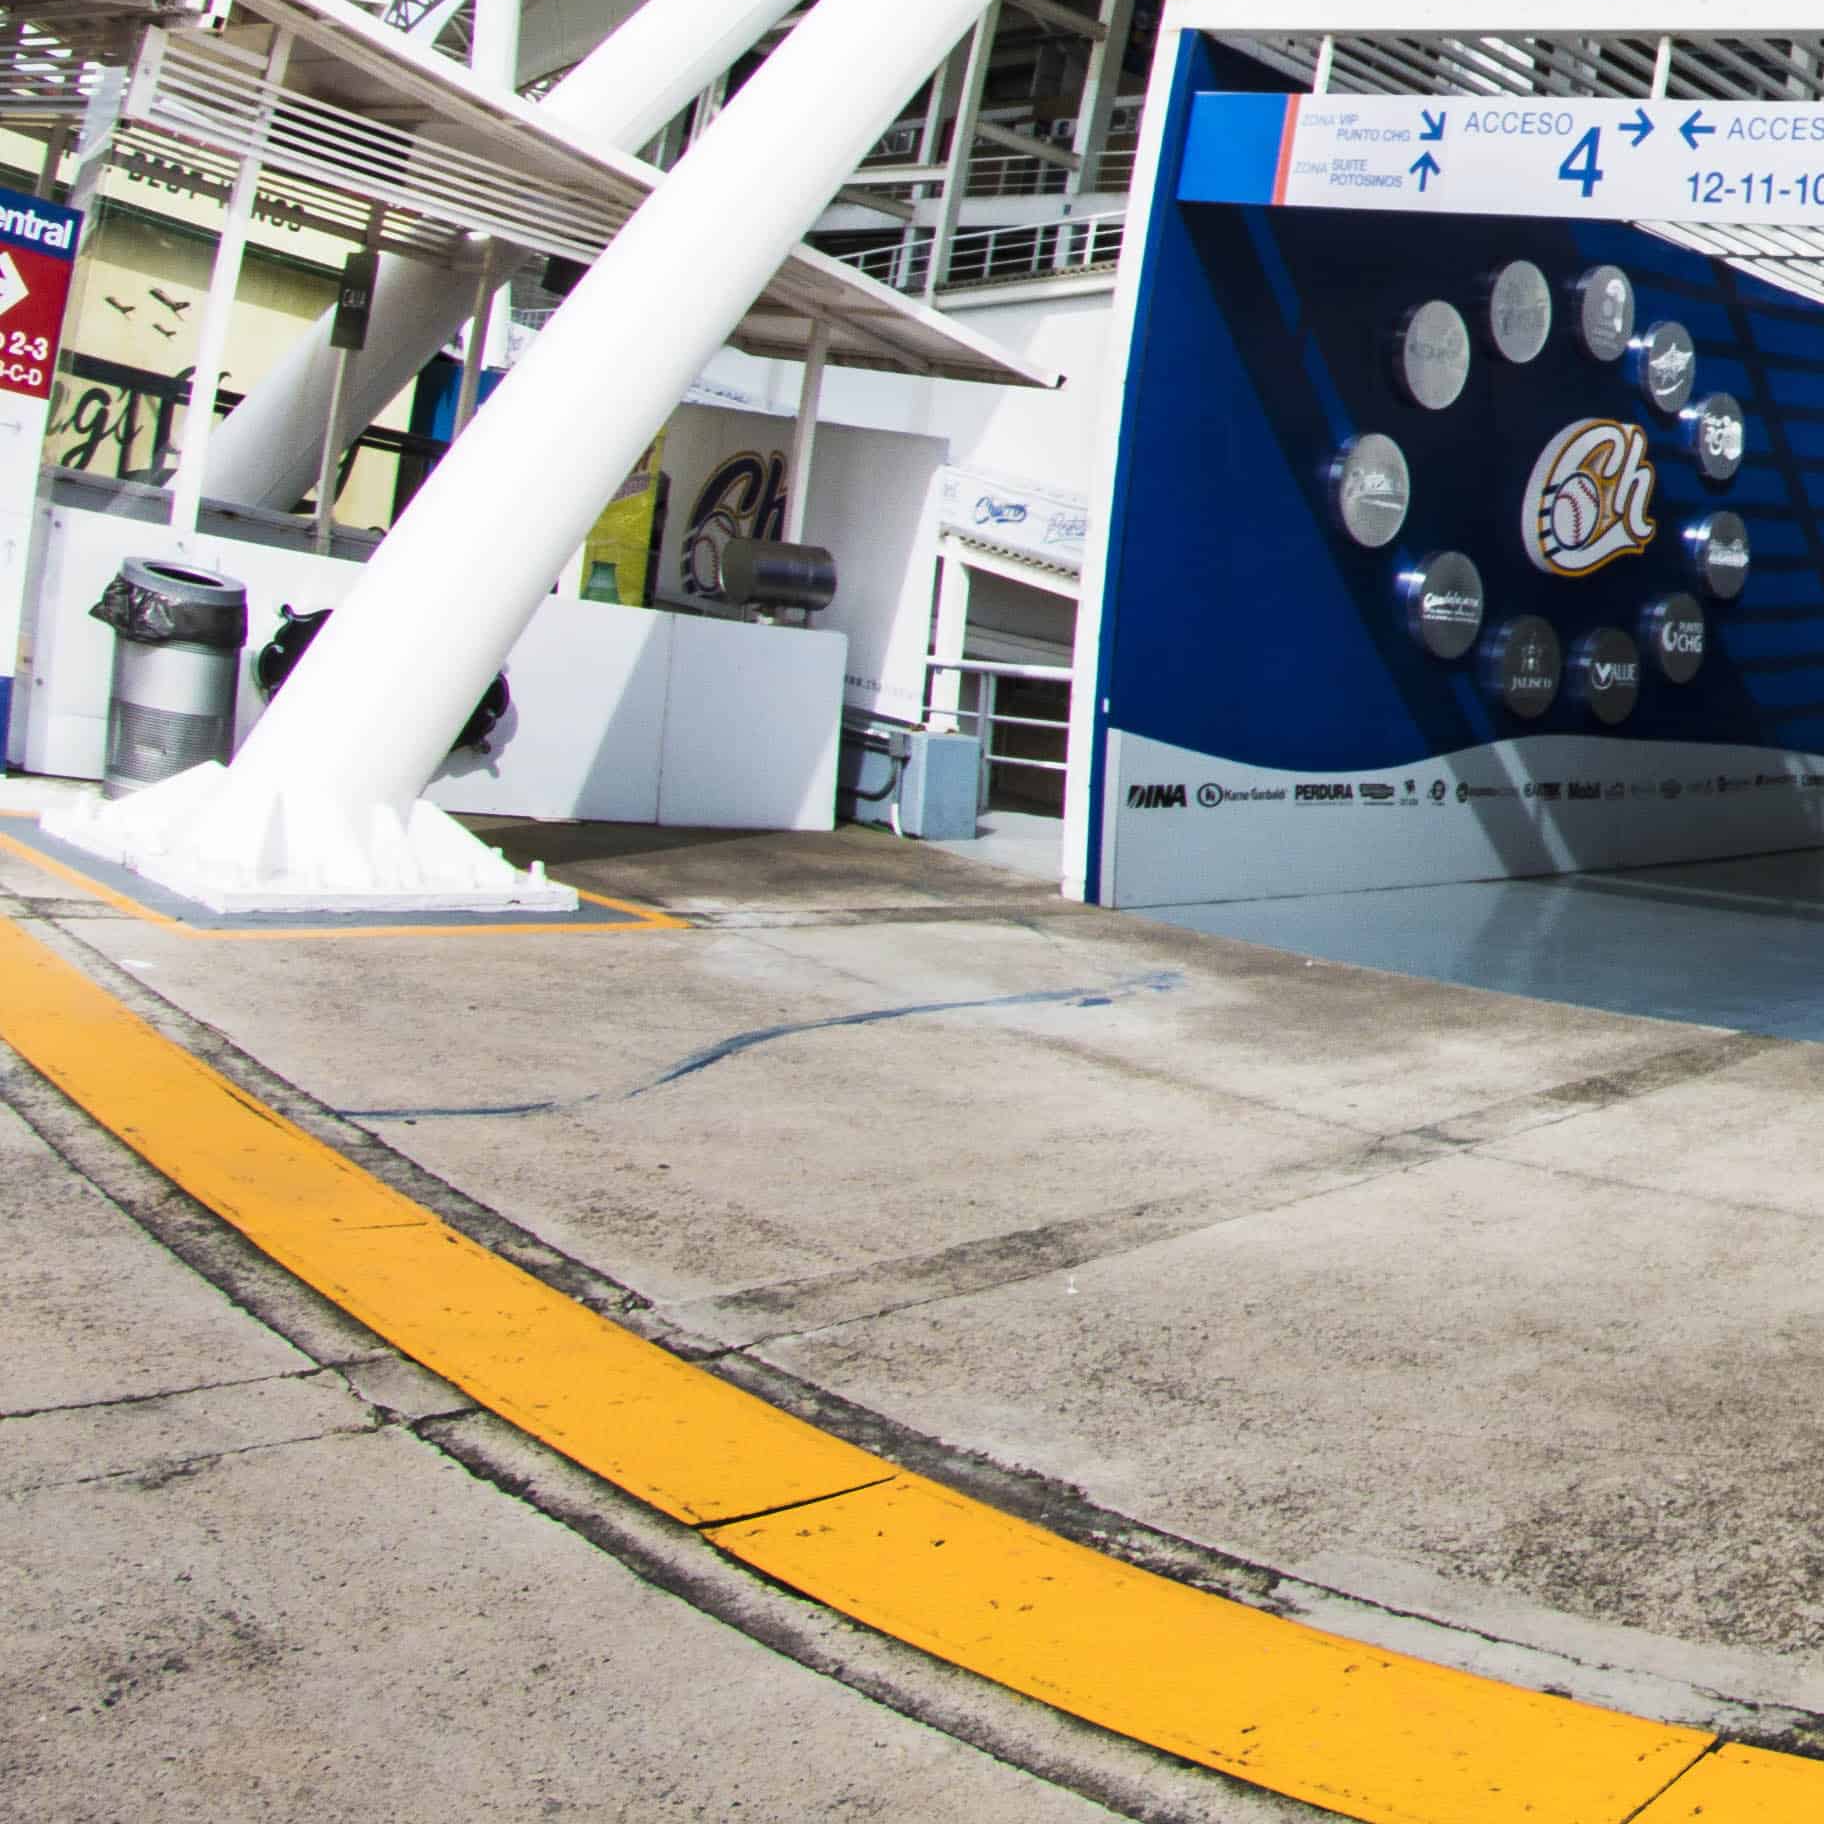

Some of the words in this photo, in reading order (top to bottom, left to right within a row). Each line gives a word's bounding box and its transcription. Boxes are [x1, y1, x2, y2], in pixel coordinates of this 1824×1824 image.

[1338, 113, 1359, 127] VIP
[1336, 129, 1380, 142] PUNTO
[1382, 129, 1411, 143] CHG
[1464, 111, 1574, 136] ACCESO
[1558, 126, 1603, 198] 4
[1330, 159, 1368, 173] SUITE
[1329, 174, 1404, 188] POTOSINOS
[0, 204, 73, 249] ntral
[9, 330, 49, 360] 2-3
[0, 360, 42, 386] -C-D
[1127, 784, 1187, 809] DINA
[1295, 783, 1353, 801] PERDURA
